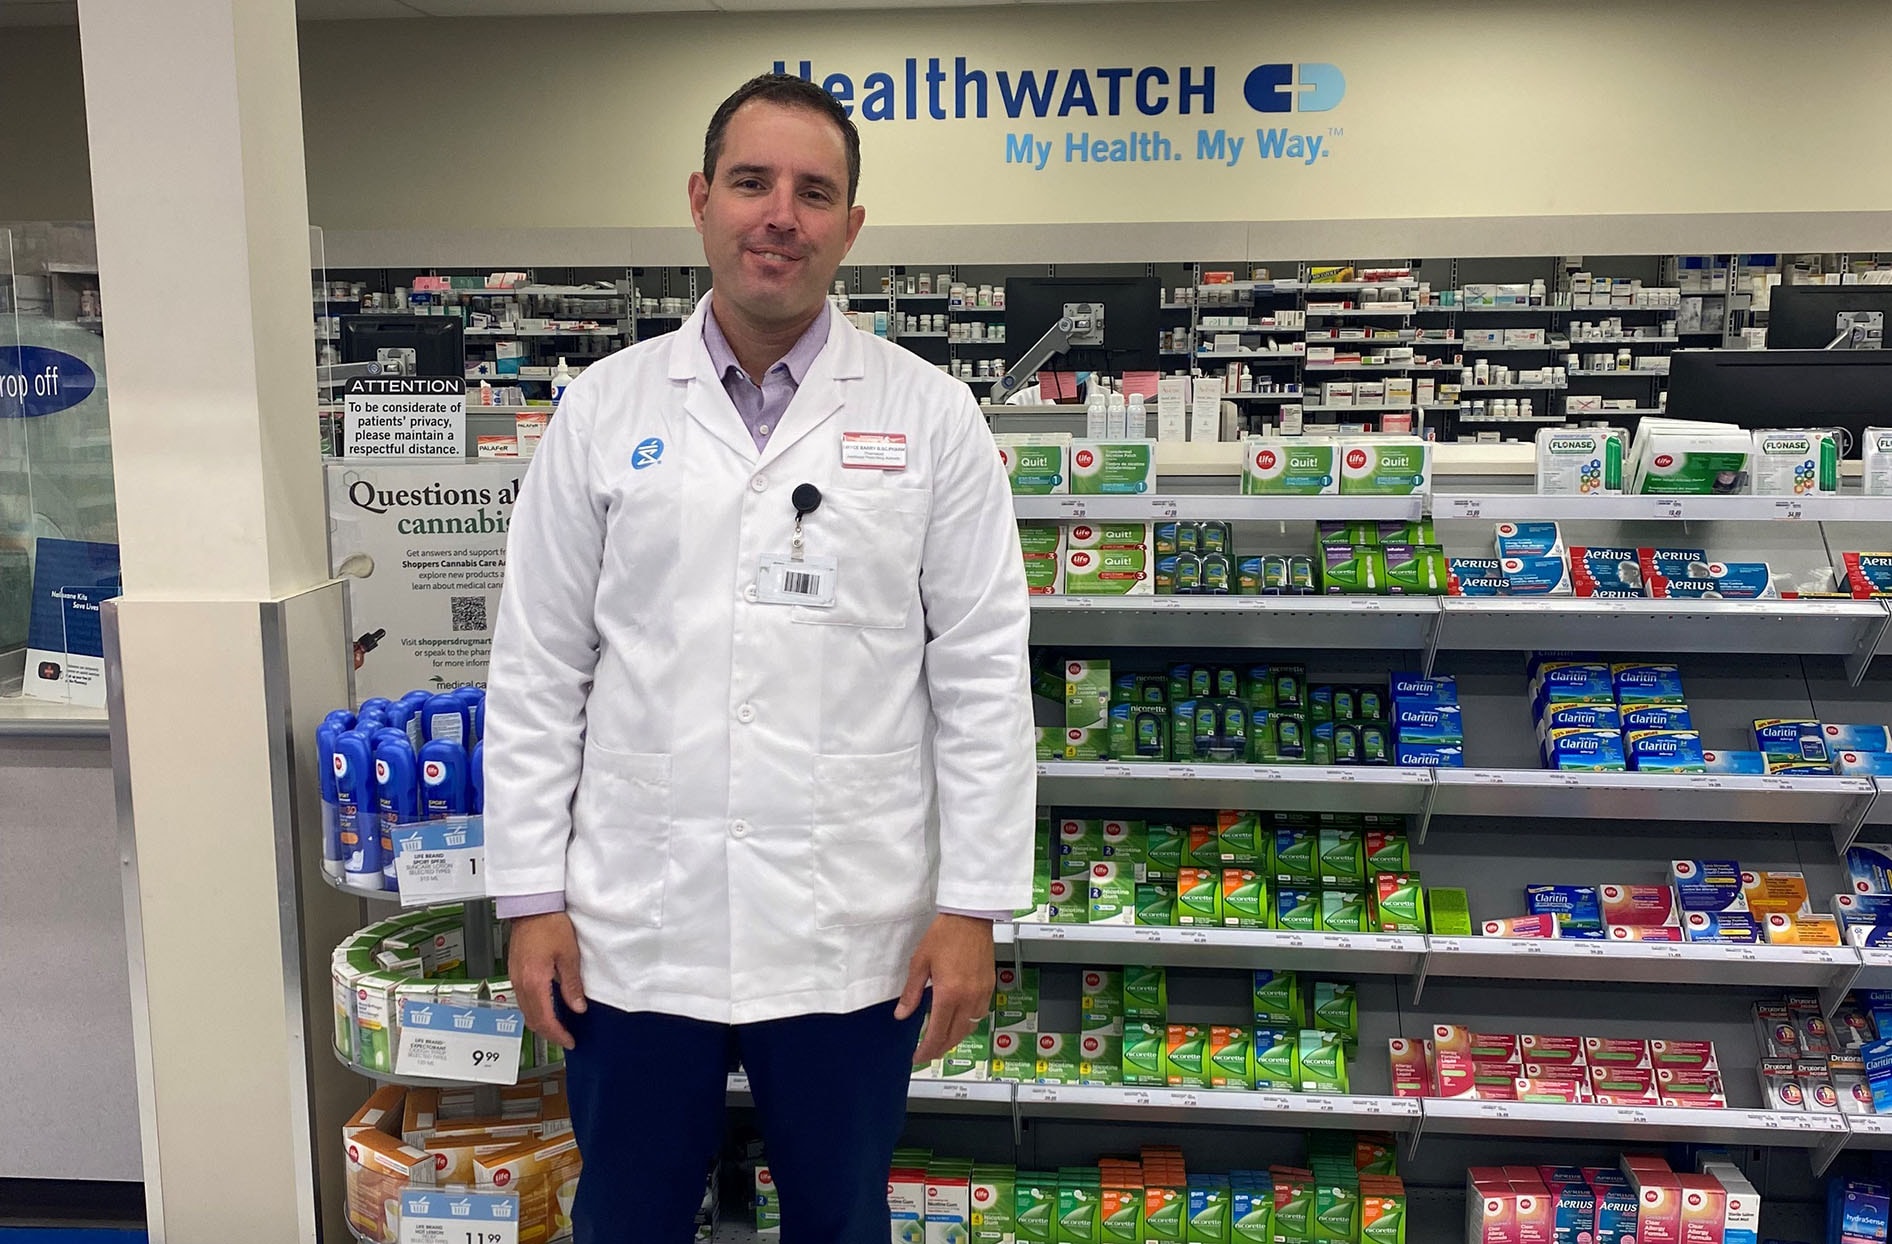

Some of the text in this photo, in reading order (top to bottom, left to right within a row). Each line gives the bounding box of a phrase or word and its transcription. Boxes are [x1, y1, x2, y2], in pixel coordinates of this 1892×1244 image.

[773, 56, 1215, 121] ealthWATCH
[1005, 127, 1330, 171] My Health. My Way.
[34, 366, 59, 397] off
[351, 379, 459, 393] ATTENTION
[349, 402, 462, 413] To be considerate of
[358, 417, 452, 429] patients' privacy,
[355, 430, 454, 442] please maintain a
[350, 443, 460, 456] respectful distance.
[1552, 441, 1593, 449] FLONASE
[1766, 441, 1807, 449] FLONASE
[1021, 457, 1048, 467] Quit!
[1078, 453, 1092, 463] Life
[1258, 455, 1274, 464] Life
[1290, 458, 1318, 468] Quit!
[1348, 453, 1365, 464] Life
[1381, 457, 1409, 467] Quit!
[1052, 475, 1058, 485] 1
[1322, 476, 1329, 486] 1
[1414, 475, 1420, 485] 1
[1138, 482, 1143, 491] 1
[349, 480, 492, 514] Questions
[1075, 529, 1090, 537] Life
[1105, 531, 1132, 539] Quit!
[406, 549, 420, 557] Get
[453, 549, 468, 557] and
[469, 549, 499, 558] support
[402, 560, 440, 569] Shoppers
[440, 559, 478, 568] Cannabis
[478, 559, 497, 567] Care
[1073, 555, 1089, 563] Life
[1104, 557, 1131, 566] Quit!
[465, 571, 499, 579] products
[1137, 572, 1144, 580] 3
[411, 582, 432, 590] learn
[432, 582, 455, 590] about
[456, 581, 486, 589] medical
[1045, 587, 1052, 595] 3
[86, 602, 99, 611] Lives
[400, 638, 492, 647] Visit shoppersdrugmart
[424, 649, 446, 657] speak
[432, 659, 444, 667] for
[465, 659, 490, 667] inform
[1550, 671, 1587, 681] Claritin
[1620, 672, 1657, 682] Claritin
[436, 680, 473, 690] medical
[1397, 681, 1433, 692] Claritin
[1130, 705, 1167, 713] nicorette
[1401, 711, 1438, 723] Claritin
[1558, 712, 1595, 723] Claritin
[1629, 714, 1667, 724] Claritin
[1762, 728, 1797, 737] Claritin
[1560, 738, 1598, 749] Claritin
[1638, 741, 1677, 751] Claritin
[1401, 754, 1439, 766] Claritin
[1095, 866, 1107, 875] Life
[1535, 893, 1568, 903] Claritin
[1258, 1056, 1290, 1064] nicorette
[1303, 1058, 1335, 1066] nicorette
[494, 1172, 509, 1182] Life
[1846, 1213, 1886, 1226] hydraSense
